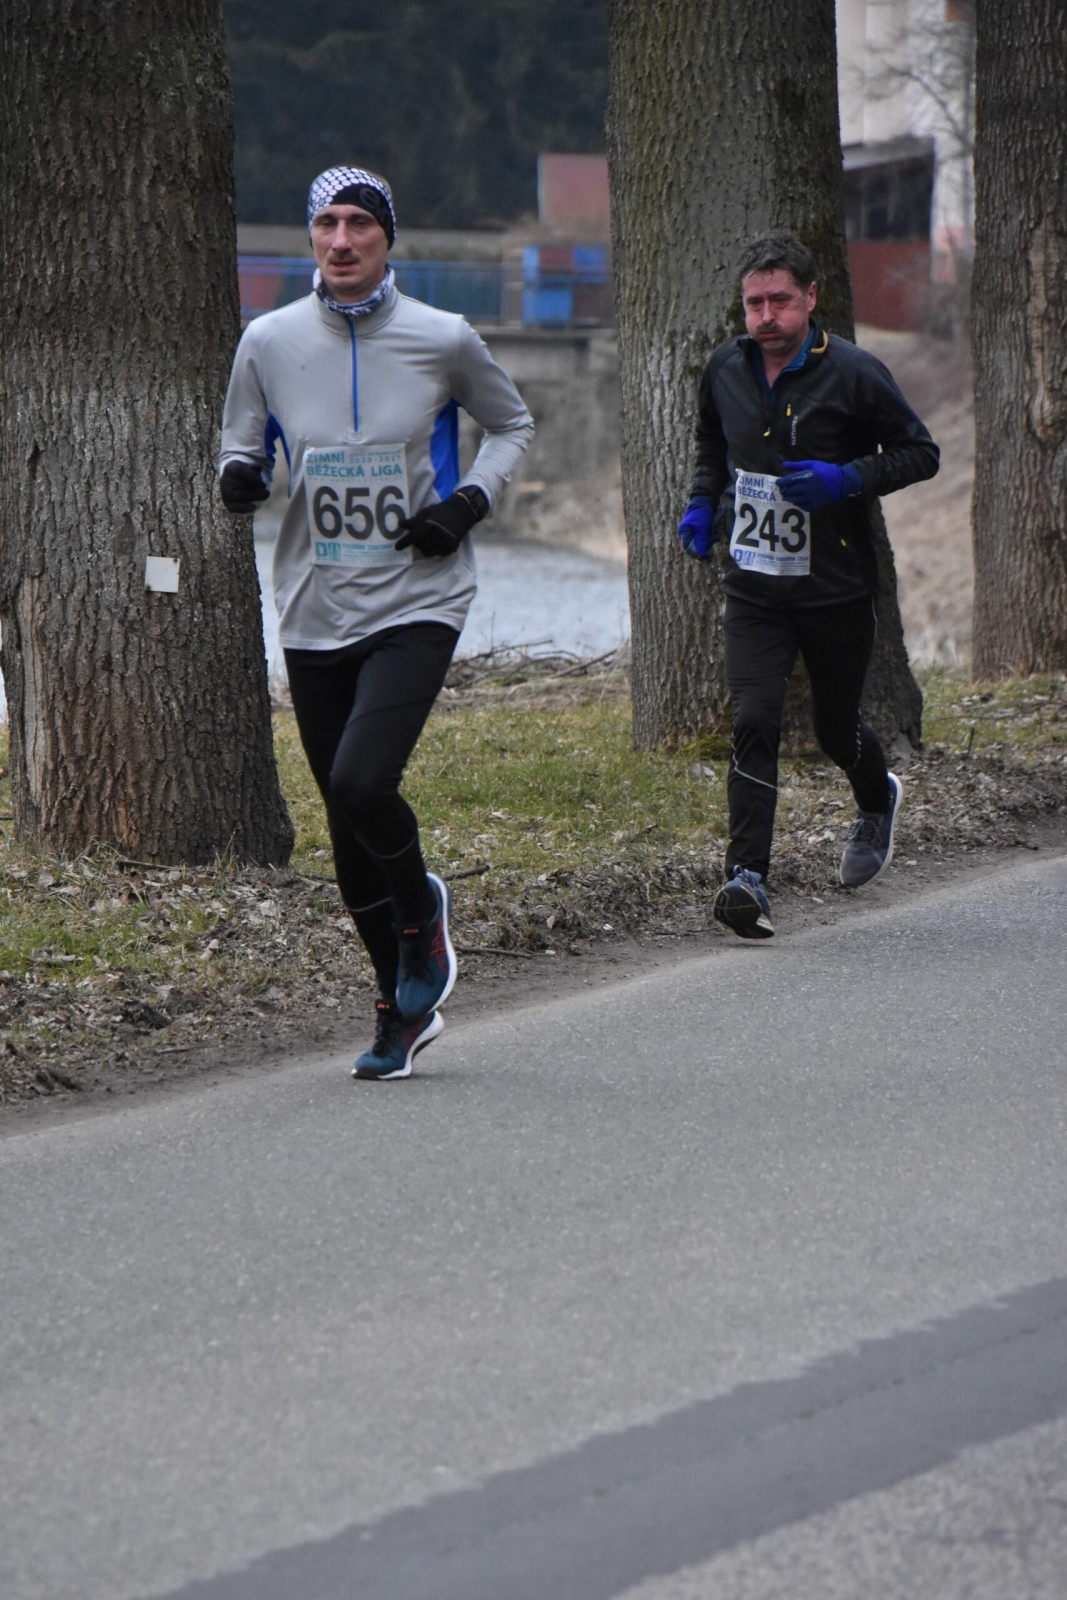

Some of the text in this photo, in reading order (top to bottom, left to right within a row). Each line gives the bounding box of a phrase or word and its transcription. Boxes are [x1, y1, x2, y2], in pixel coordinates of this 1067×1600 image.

[306, 451, 345, 463] ZIMNÍ
[349, 454, 401, 463] 2020-2021
[306, 464, 402, 478] BĚŽECKÁ LIGA
[737, 486, 777, 502] BĚŽECKÁ
[312, 485, 407, 541] 656
[735, 502, 806, 553] 243
